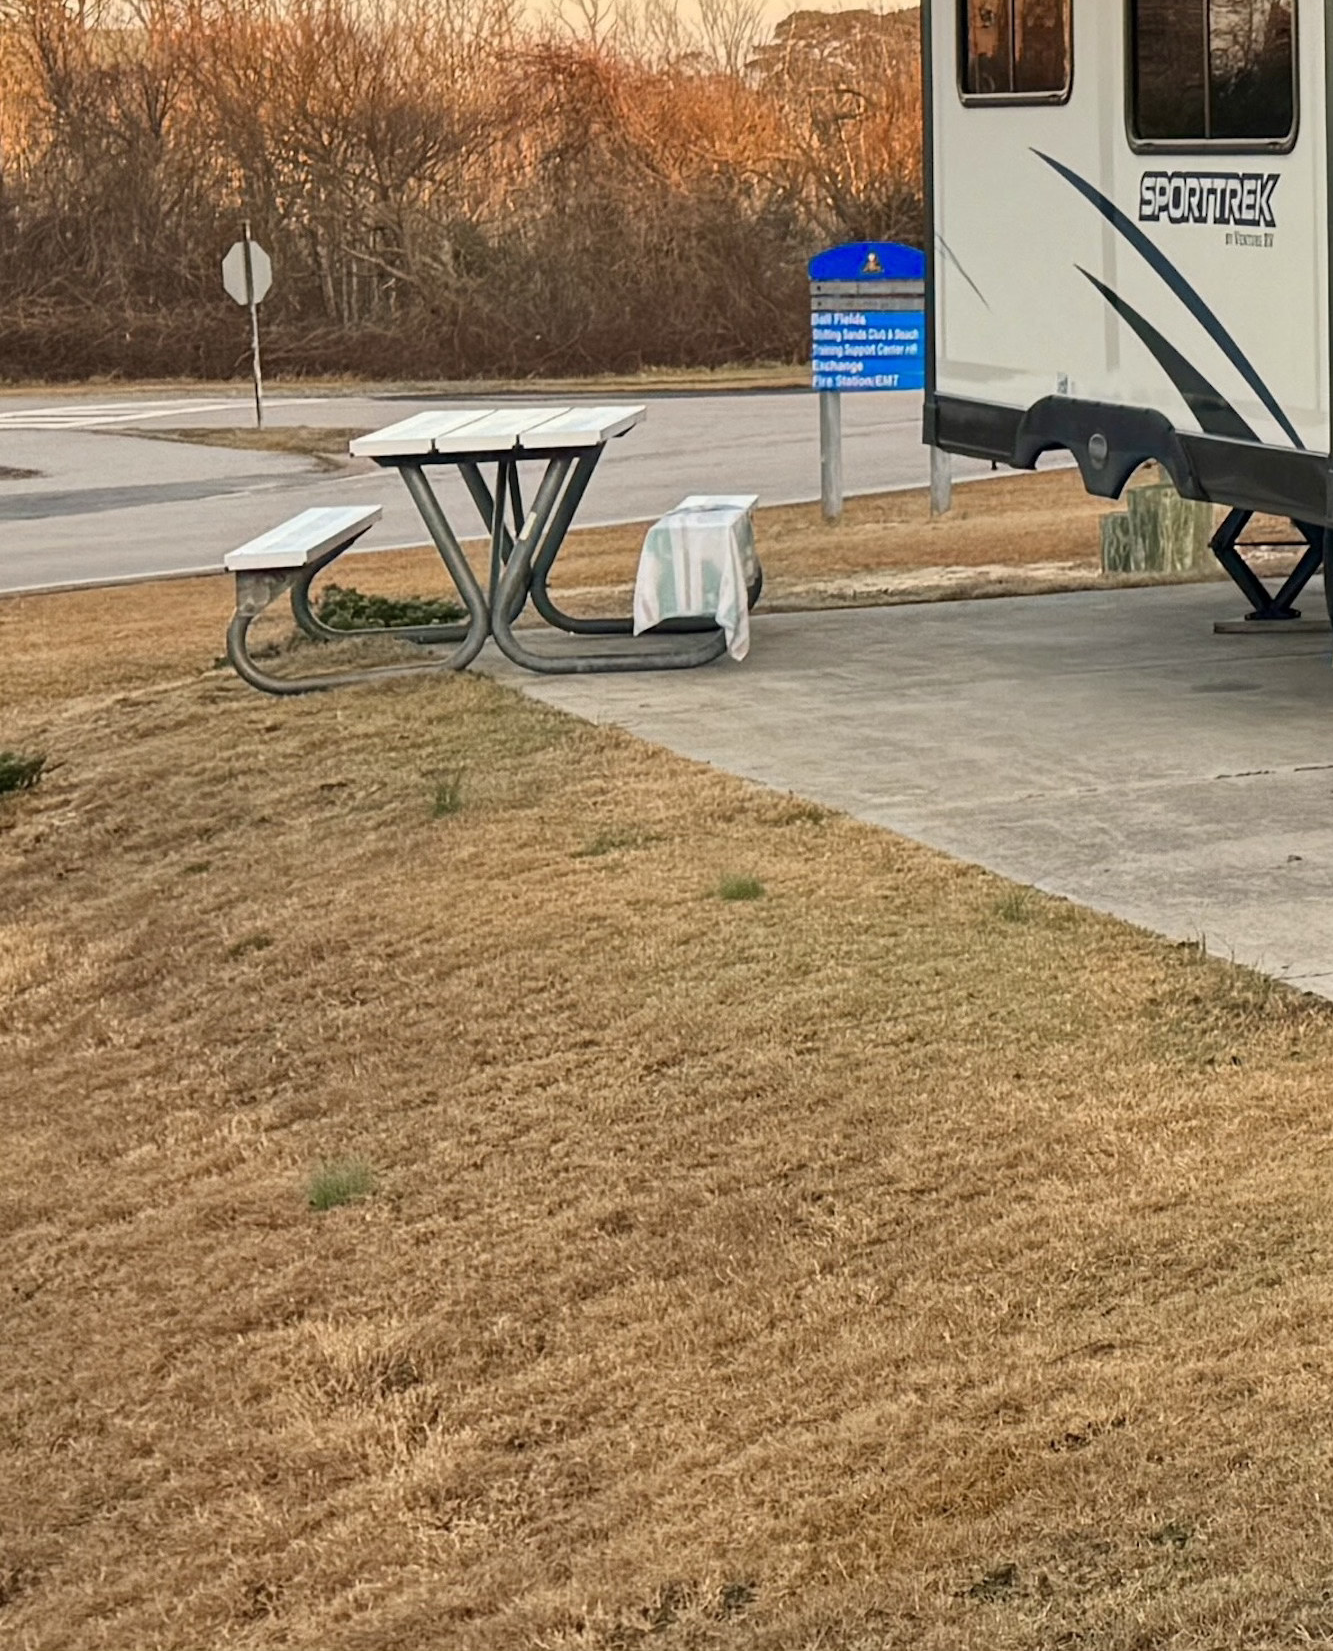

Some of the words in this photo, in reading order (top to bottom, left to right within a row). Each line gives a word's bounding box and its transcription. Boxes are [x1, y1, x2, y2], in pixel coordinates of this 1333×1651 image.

[1139, 172, 1280, 226] SPORTTREK
[833, 312, 866, 325] Fields
[812, 343, 843, 358] Training
[844, 343, 876, 357] Support
[877, 343, 904, 356] Center
[812, 360, 864, 374] Exchange
[812, 375, 833, 388] Fire
